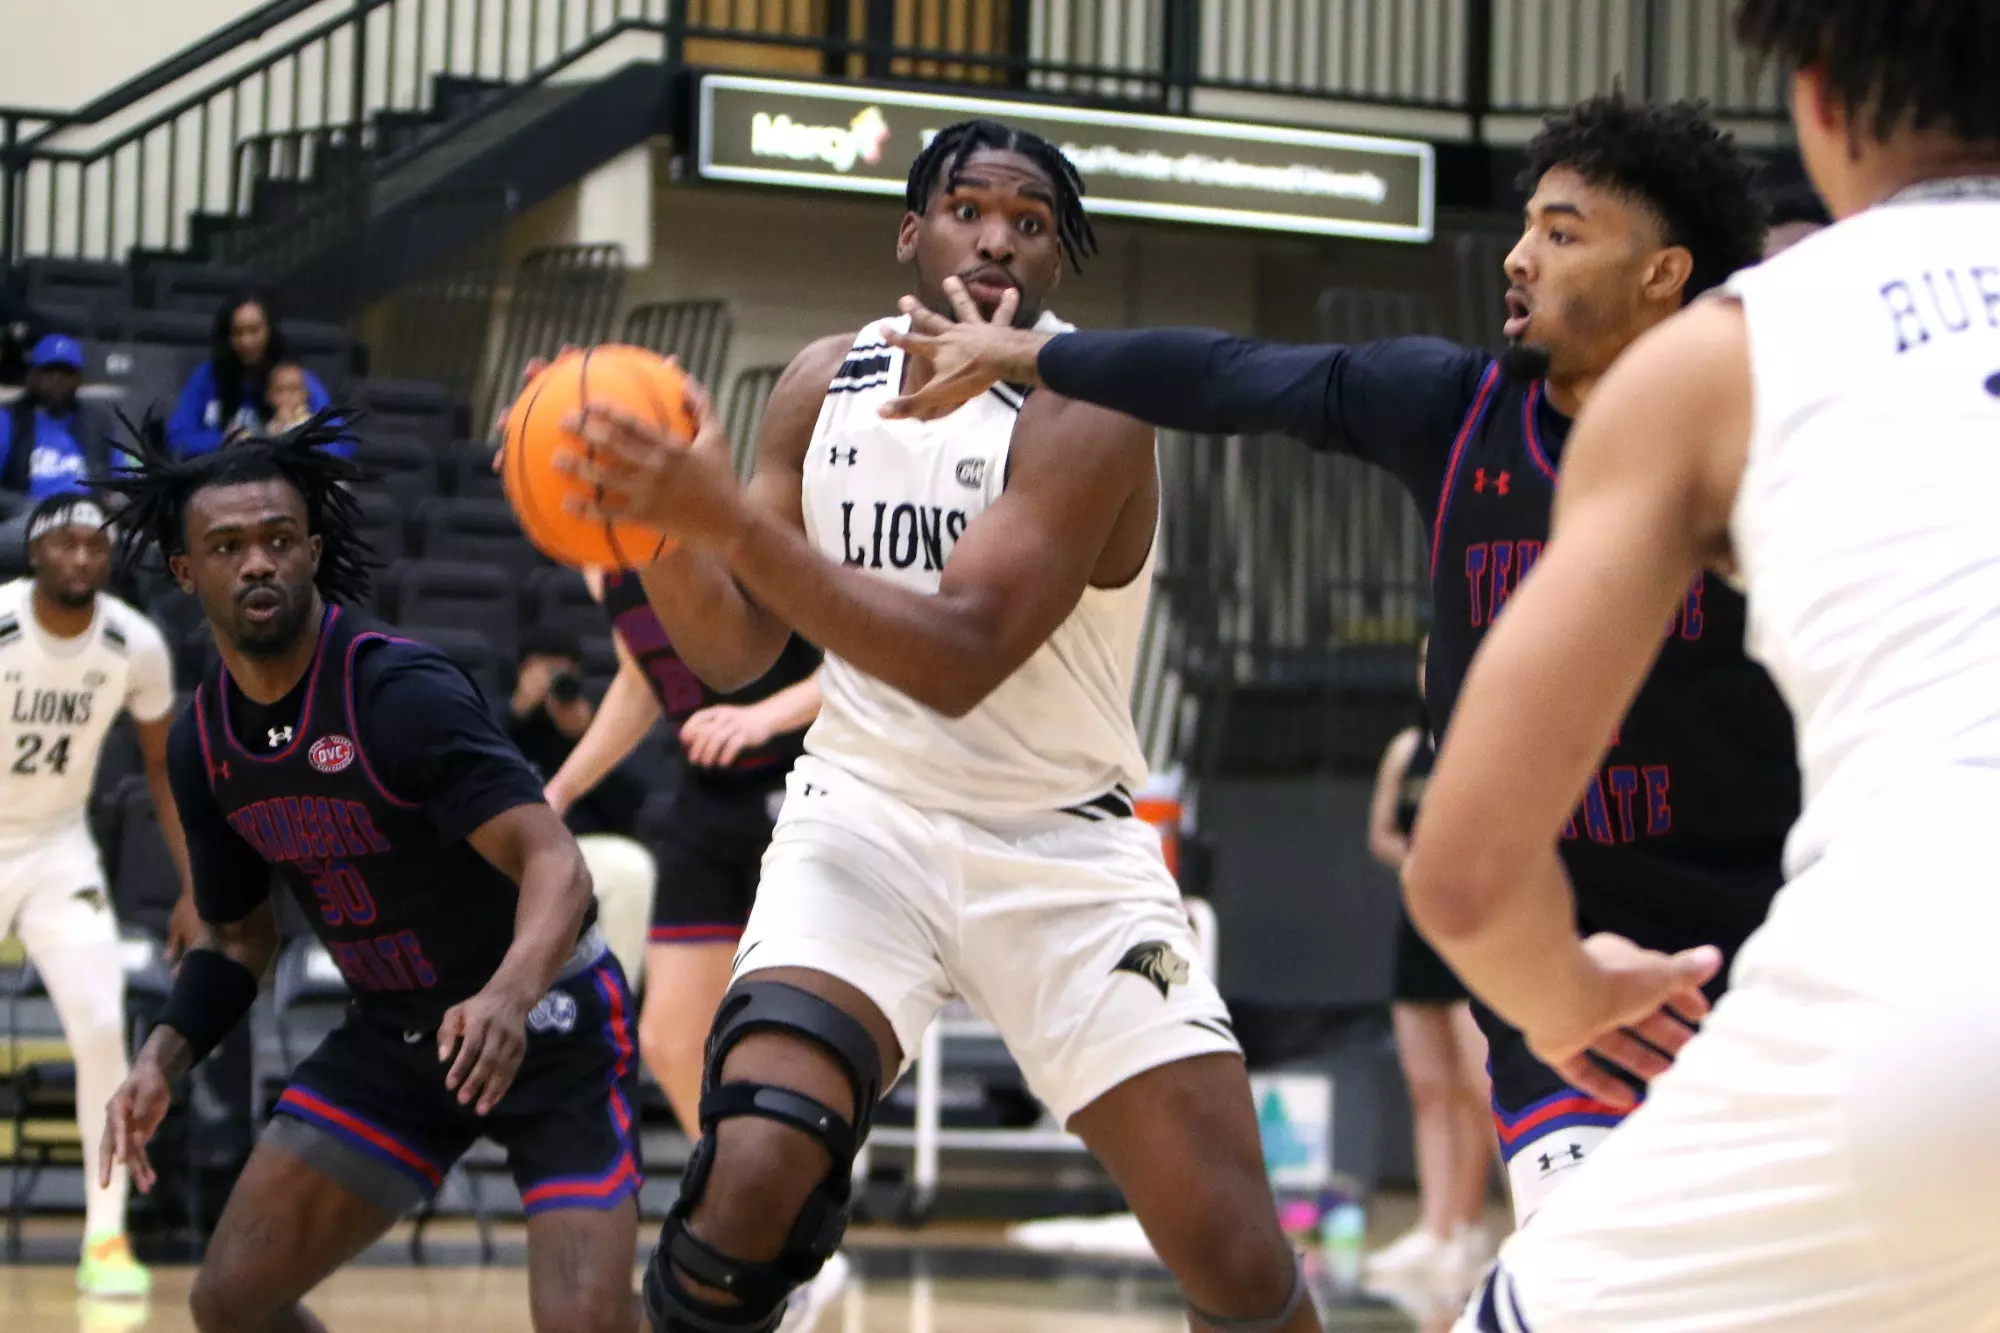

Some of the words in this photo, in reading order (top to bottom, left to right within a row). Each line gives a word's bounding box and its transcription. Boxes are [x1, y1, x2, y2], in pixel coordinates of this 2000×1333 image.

[11, 687, 93, 725] LIONS
[11, 732, 71, 775] 24
[318, 745, 345, 763] OVC
[297, 857, 377, 926] 30
